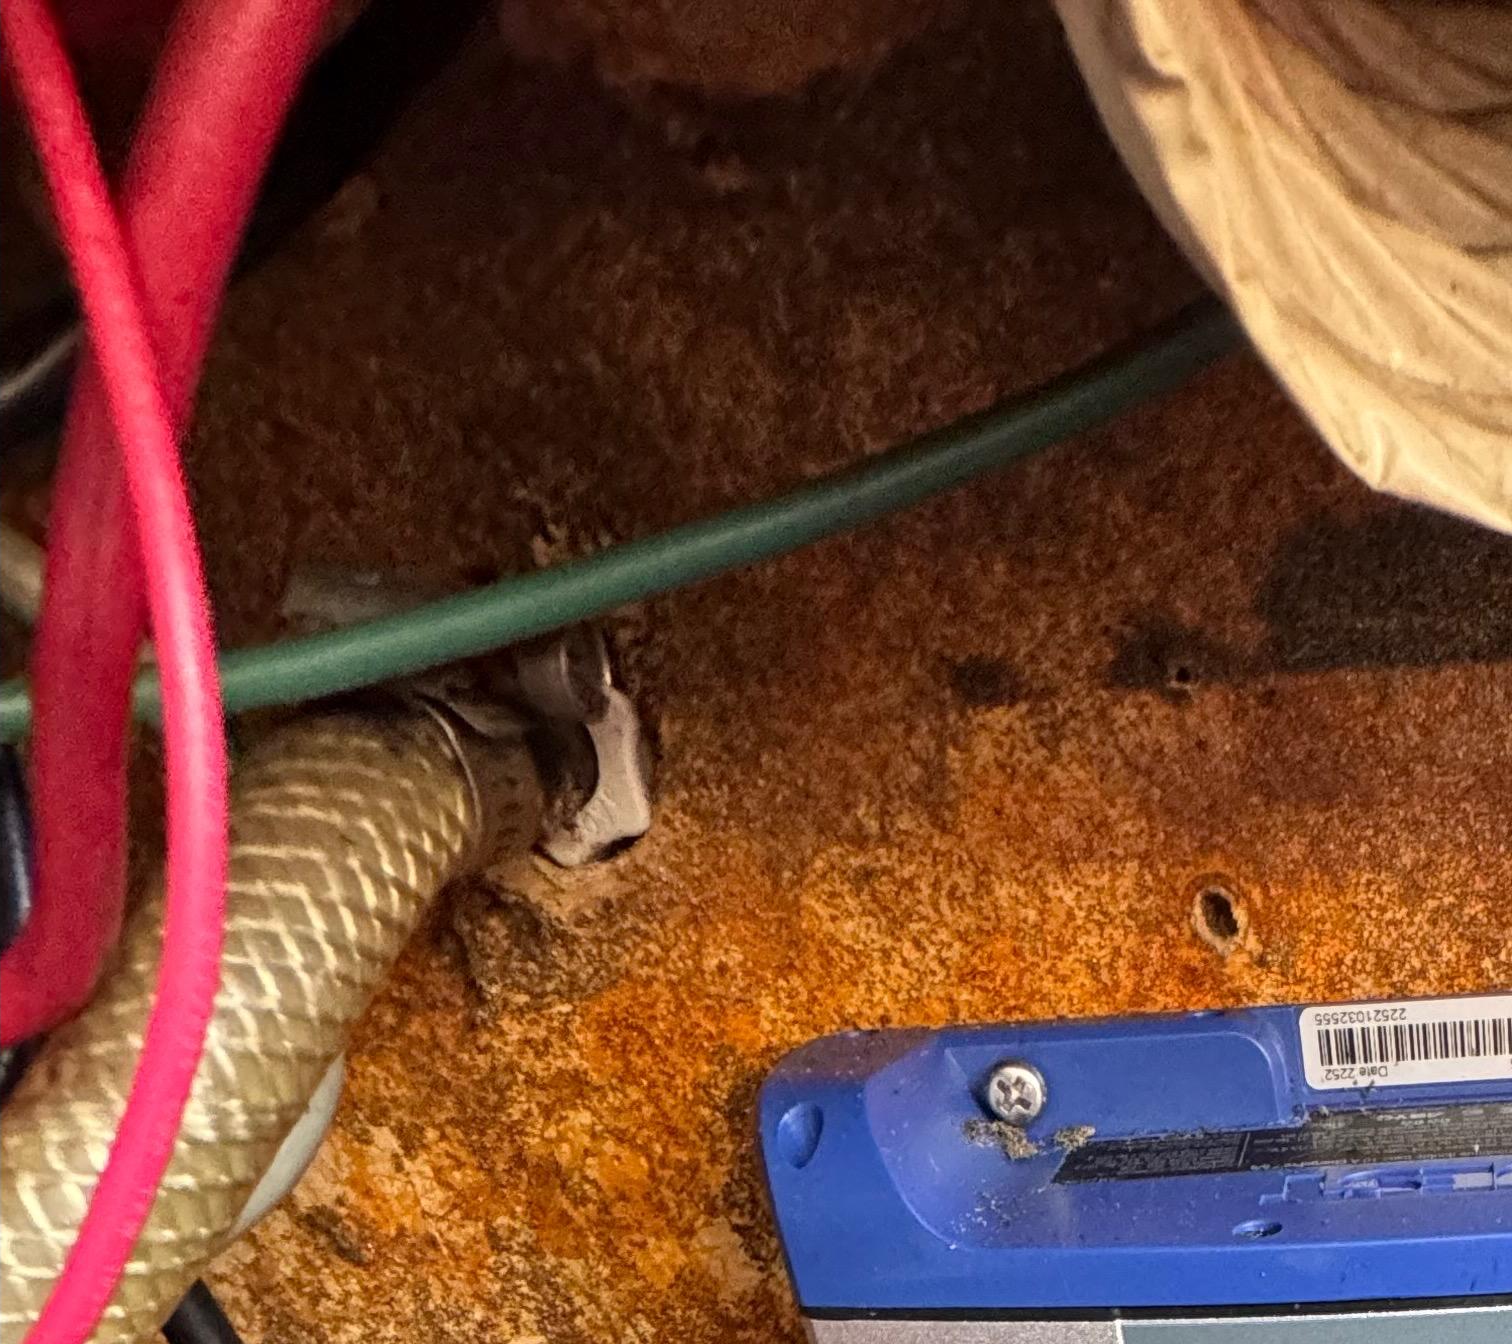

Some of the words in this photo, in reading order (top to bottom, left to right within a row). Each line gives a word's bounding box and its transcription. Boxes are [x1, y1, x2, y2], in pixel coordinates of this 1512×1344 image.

[1312, 1005, 1407, 1027] 22521032555
[1321, 1065, 1356, 1081] 2252
[1357, 1063, 1388, 1079] Date
